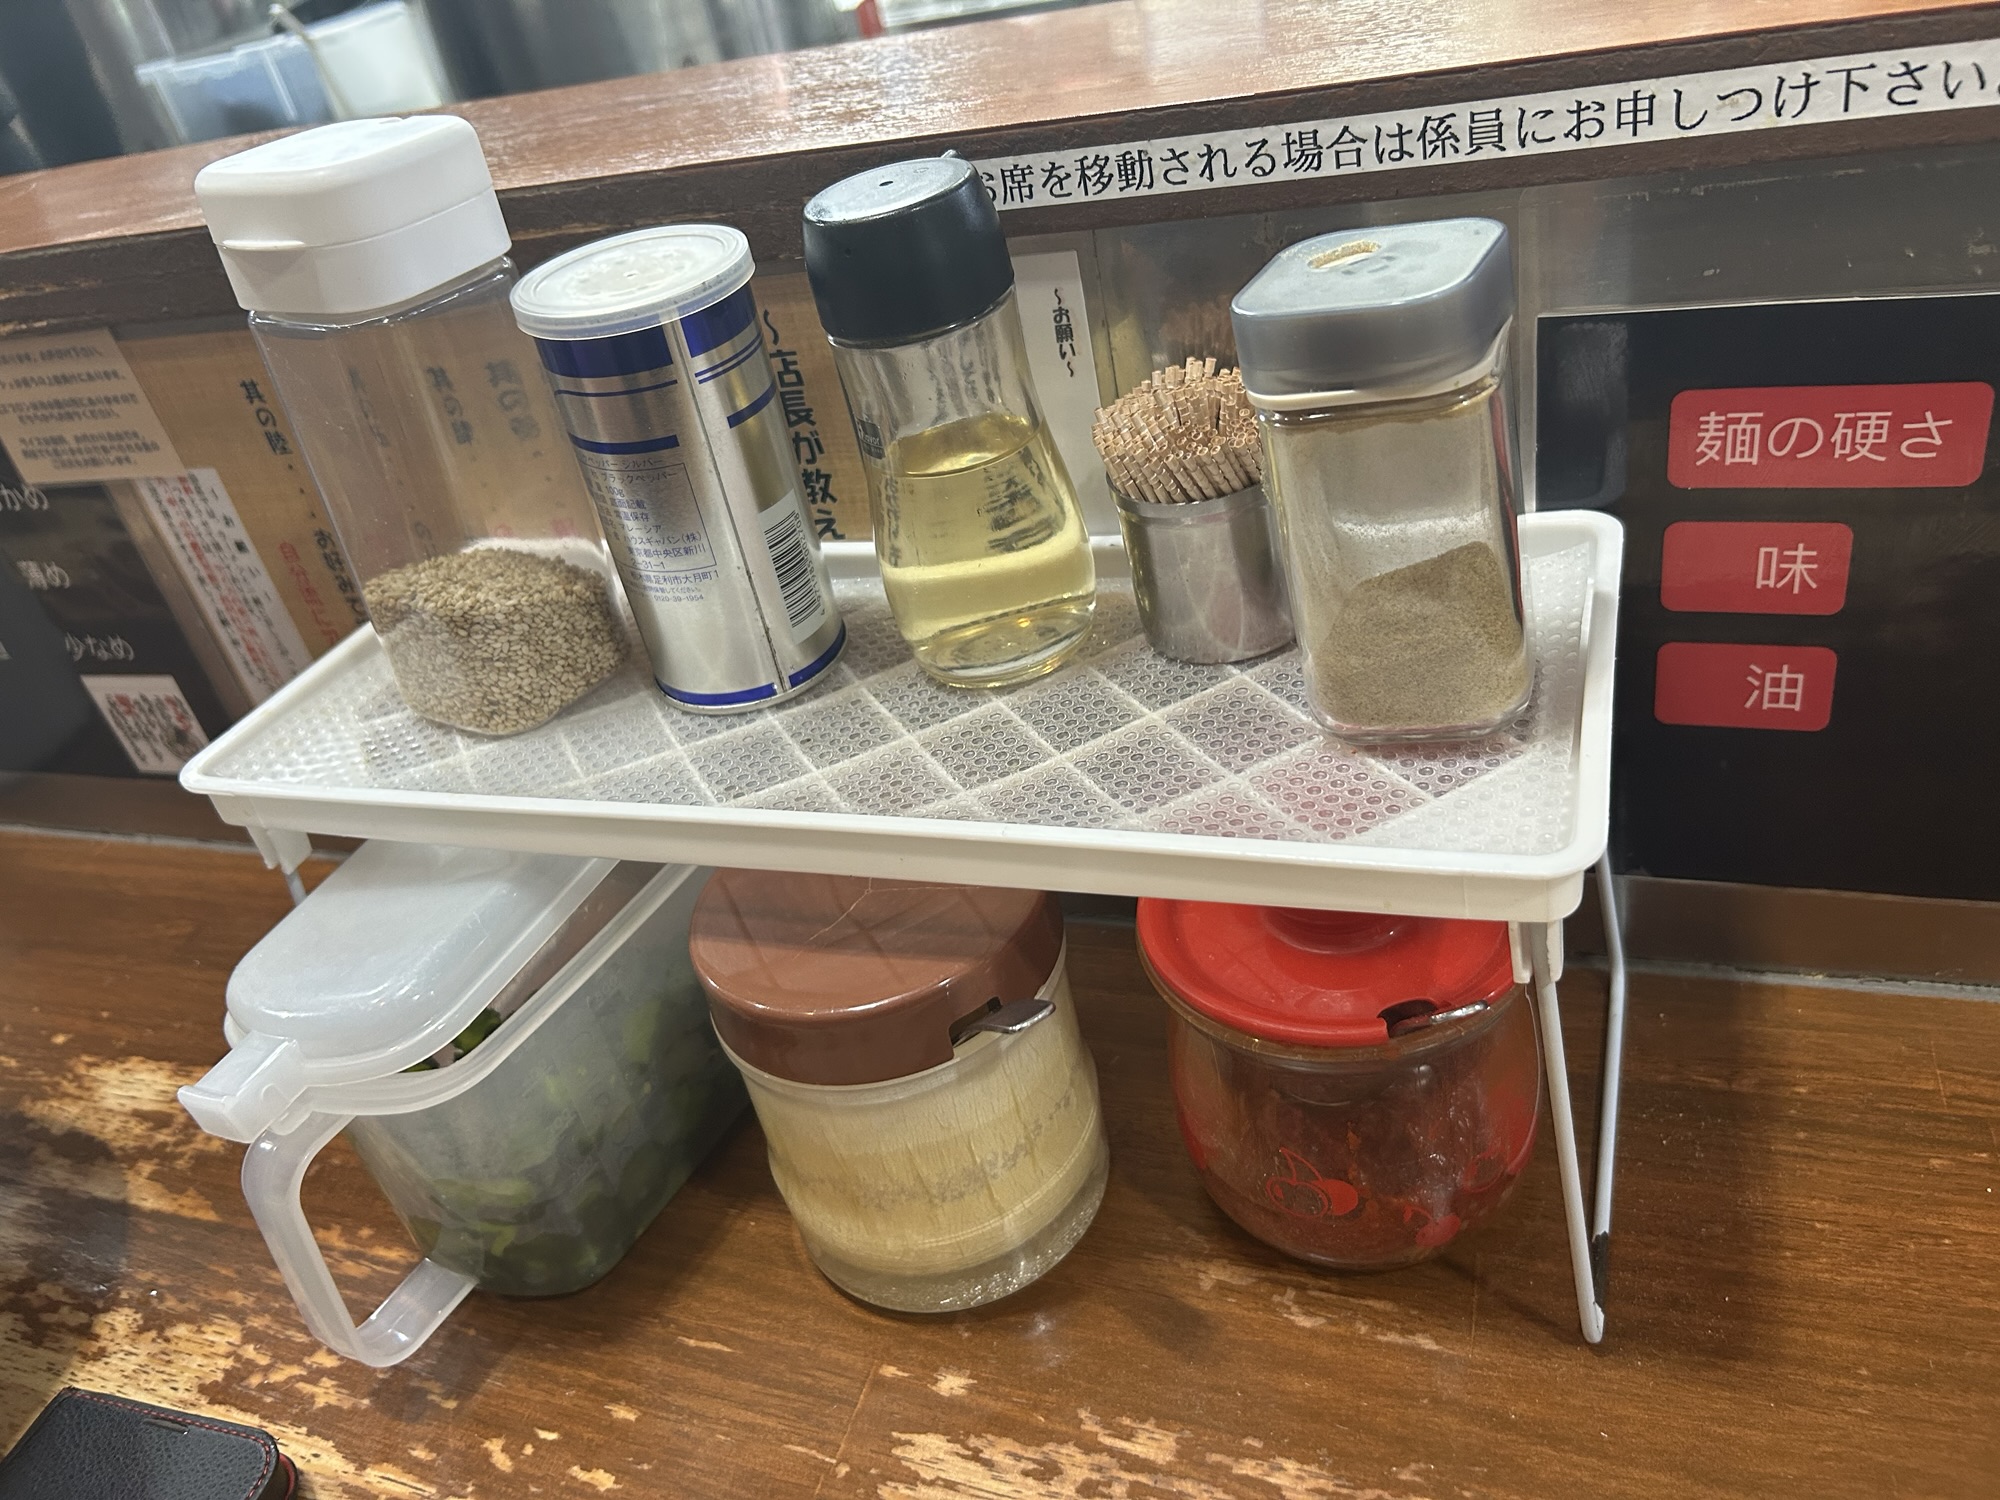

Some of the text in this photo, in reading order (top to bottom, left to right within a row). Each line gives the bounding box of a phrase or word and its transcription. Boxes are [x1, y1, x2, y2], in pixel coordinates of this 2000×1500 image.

[980, 59, 2000, 205] 席を移動される場合は係員にお申しつけ下さい
[1695, 410, 1953, 466] 麺の硬さ
[1755, 543, 1818, 594] 味
[1744, 664, 1804, 711] 油
